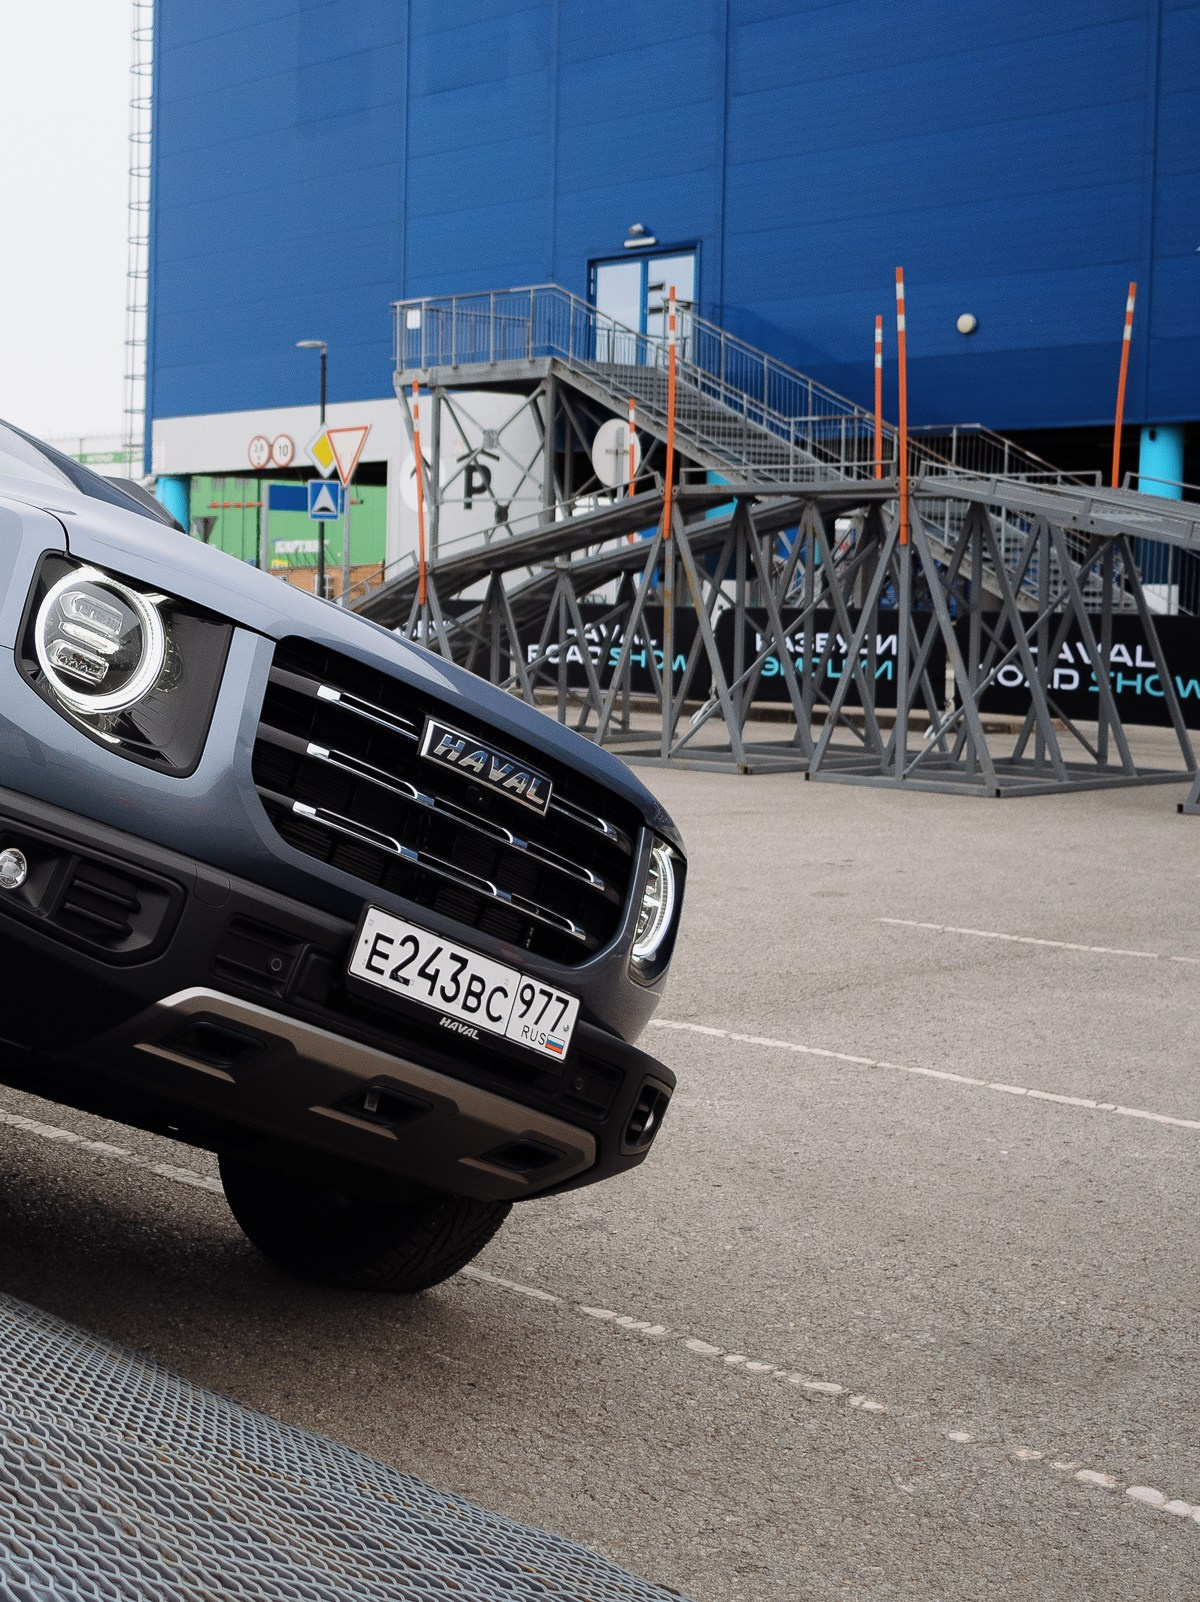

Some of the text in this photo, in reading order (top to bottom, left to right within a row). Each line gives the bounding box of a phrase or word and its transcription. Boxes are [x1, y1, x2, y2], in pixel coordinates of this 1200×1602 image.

[279, 444, 289, 457] 10
[1027, 641, 1157, 669] AVAL
[433, 733, 545, 805] HAVAL
[518, 983, 570, 1033] 977
[439, 1016, 480, 1041] HAVAL
[521, 1024, 546, 1046] RUS
